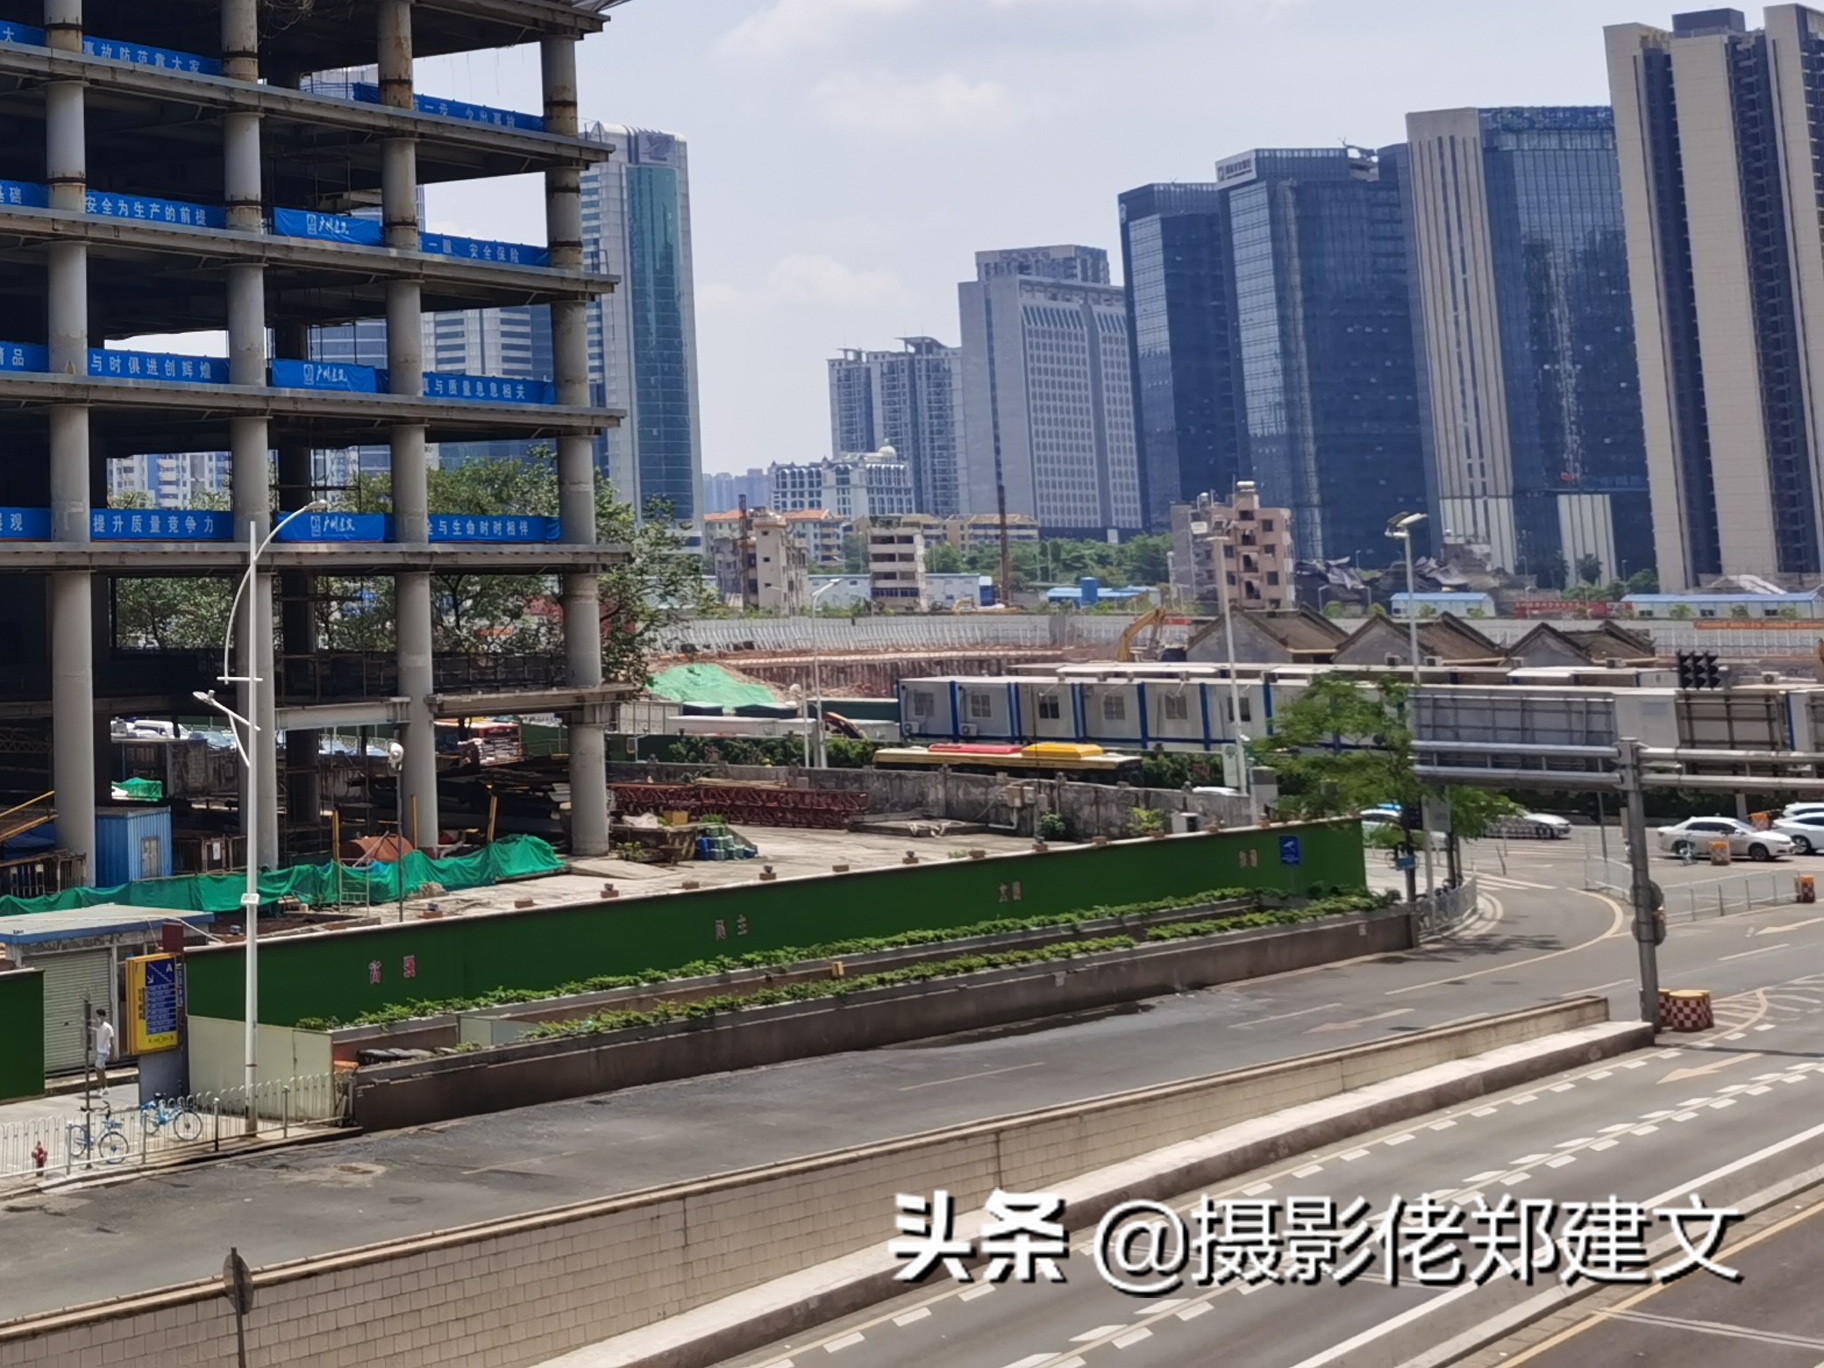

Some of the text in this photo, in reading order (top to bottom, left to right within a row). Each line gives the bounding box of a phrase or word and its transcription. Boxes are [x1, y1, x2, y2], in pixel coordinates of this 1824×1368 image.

[85, 195, 207, 226] 安全为生产的前提
[469, 243, 520, 264] 安全保险
[91, 354, 212, 379] 与时俱进创辉煌
[93, 514, 214, 534] 提升质量竞争力
[165, 963, 173, 973] A
